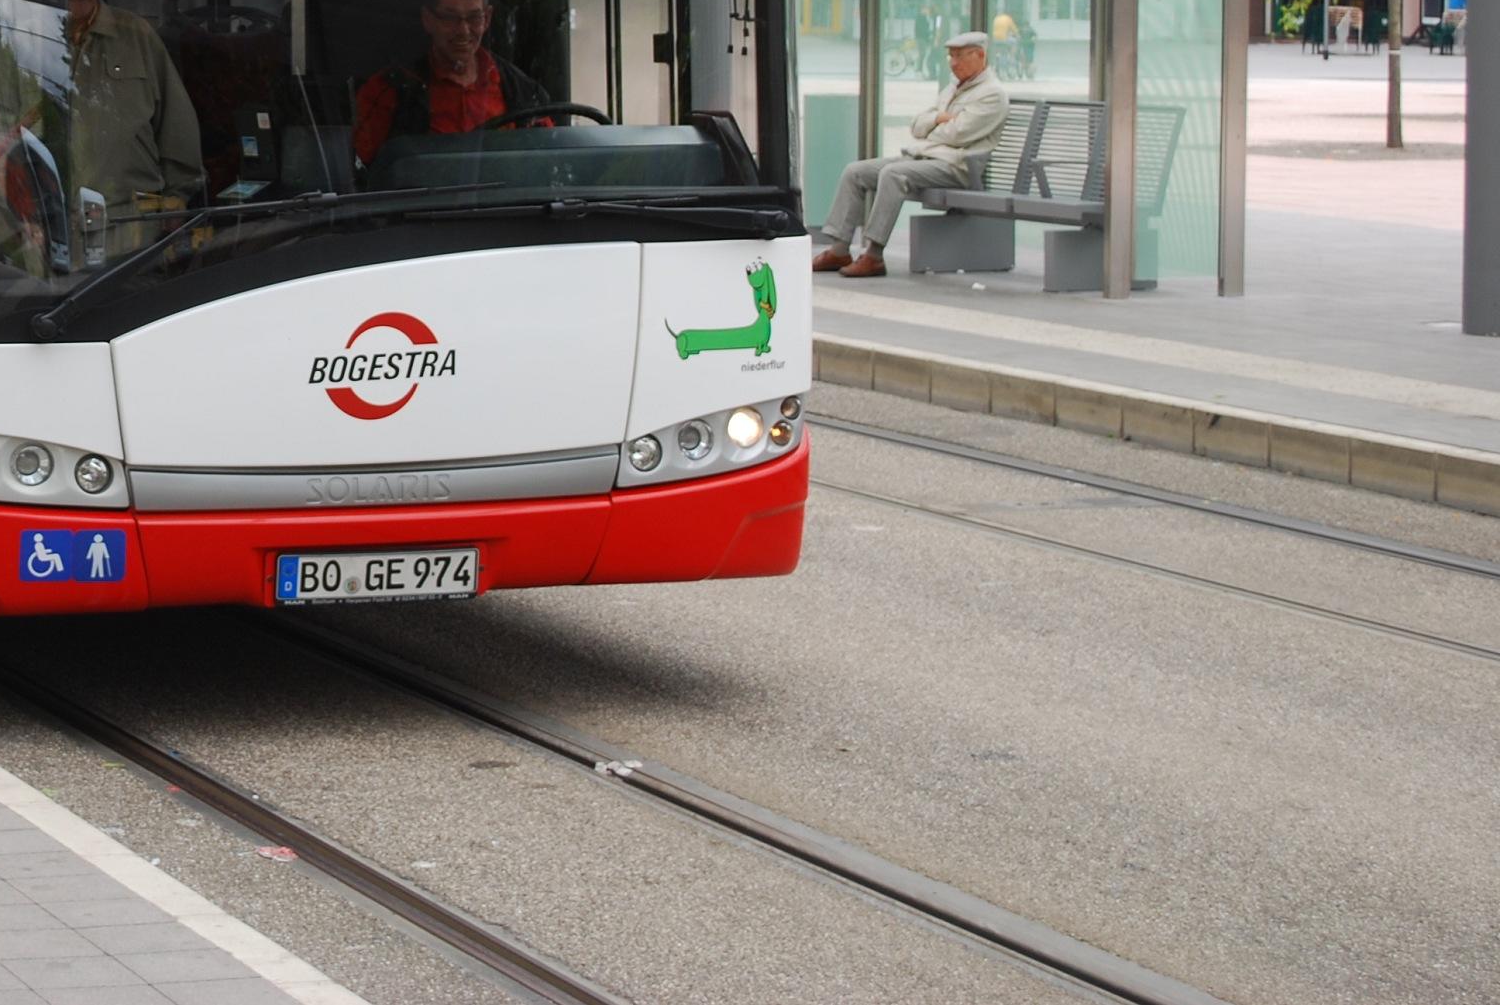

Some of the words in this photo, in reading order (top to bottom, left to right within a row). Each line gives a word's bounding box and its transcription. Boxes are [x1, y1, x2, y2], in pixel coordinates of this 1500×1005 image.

[308, 349, 456, 384] BOGESTRA
[740, 359, 786, 372] niederflur
[305, 473, 452, 504] SOLARIS
[284, 581, 293, 592] D
[300, 560, 342, 593] BO
[365, 558, 405, 591] GE
[413, 555, 471, 589] 974
